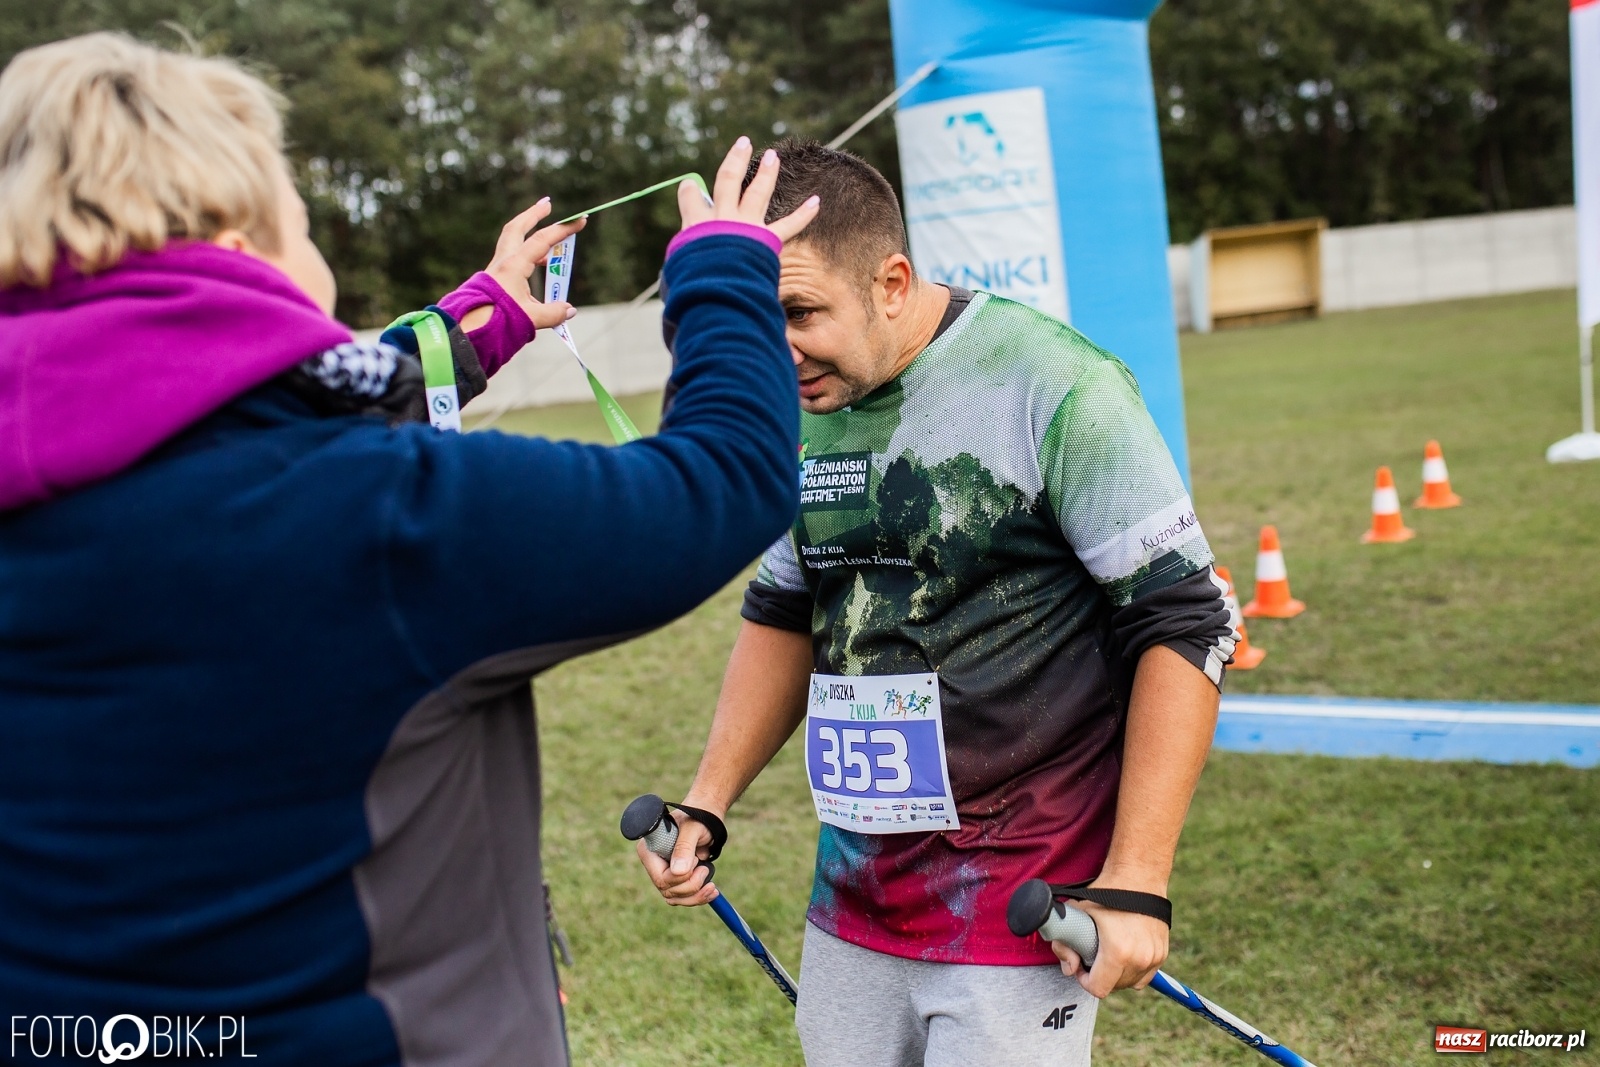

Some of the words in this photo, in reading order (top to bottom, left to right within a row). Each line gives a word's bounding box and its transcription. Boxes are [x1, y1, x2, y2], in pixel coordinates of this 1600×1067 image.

[929, 254, 1050, 291] YNIKI
[802, 473, 866, 489] PÓŁMARATON
[843, 484, 866, 494] LEŚNY
[871, 555, 913, 567] ZADYSZKA
[829, 683, 856, 701] DYSZKA
[849, 703, 855, 720] Z
[856, 704, 877, 720] KIJA
[819, 725, 913, 793] 353
[1042, 1003, 1078, 1030] 4F
